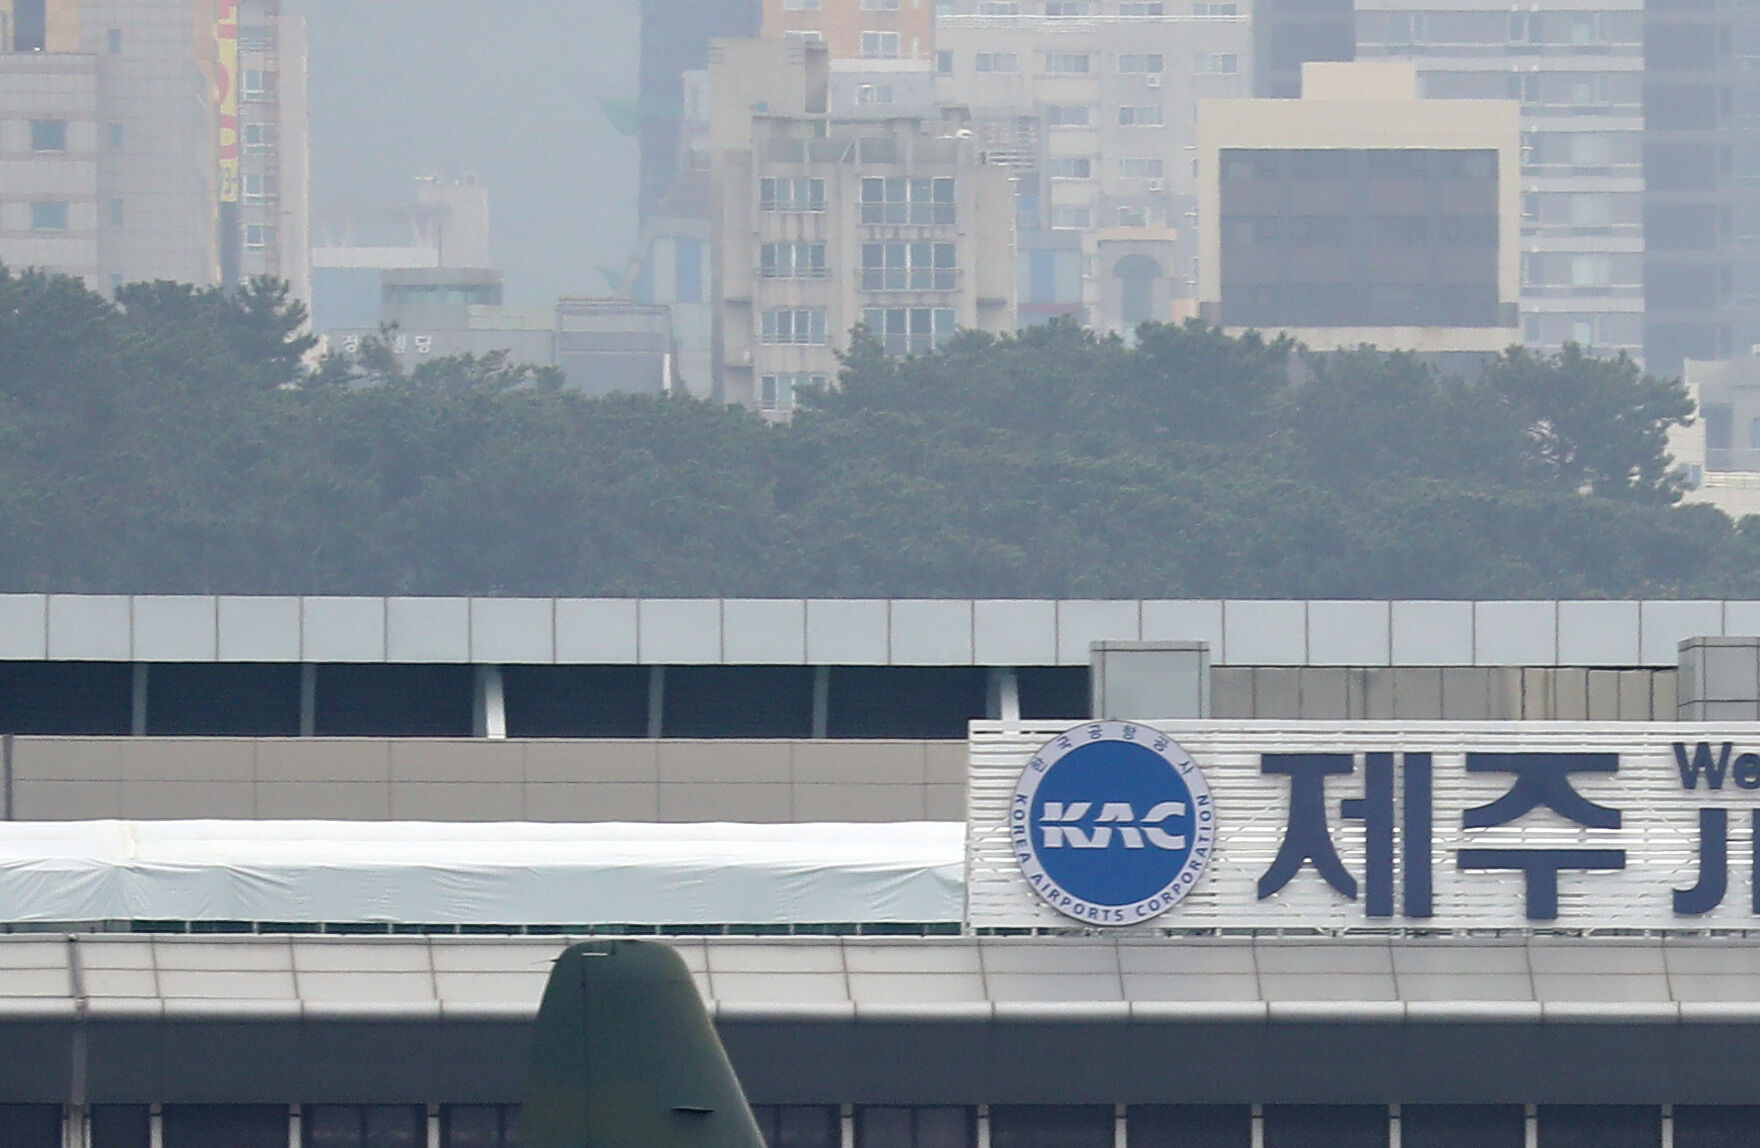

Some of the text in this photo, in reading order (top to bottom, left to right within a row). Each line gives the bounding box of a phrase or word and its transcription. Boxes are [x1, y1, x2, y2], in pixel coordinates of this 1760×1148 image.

[1030, 724, 1195, 776] 한국공항공사
[1013, 793, 1213, 922] KOREA AIRPORTS CORPORATION
[1038, 801, 1187, 850] KAC
[1257, 752, 1627, 920] 제주
